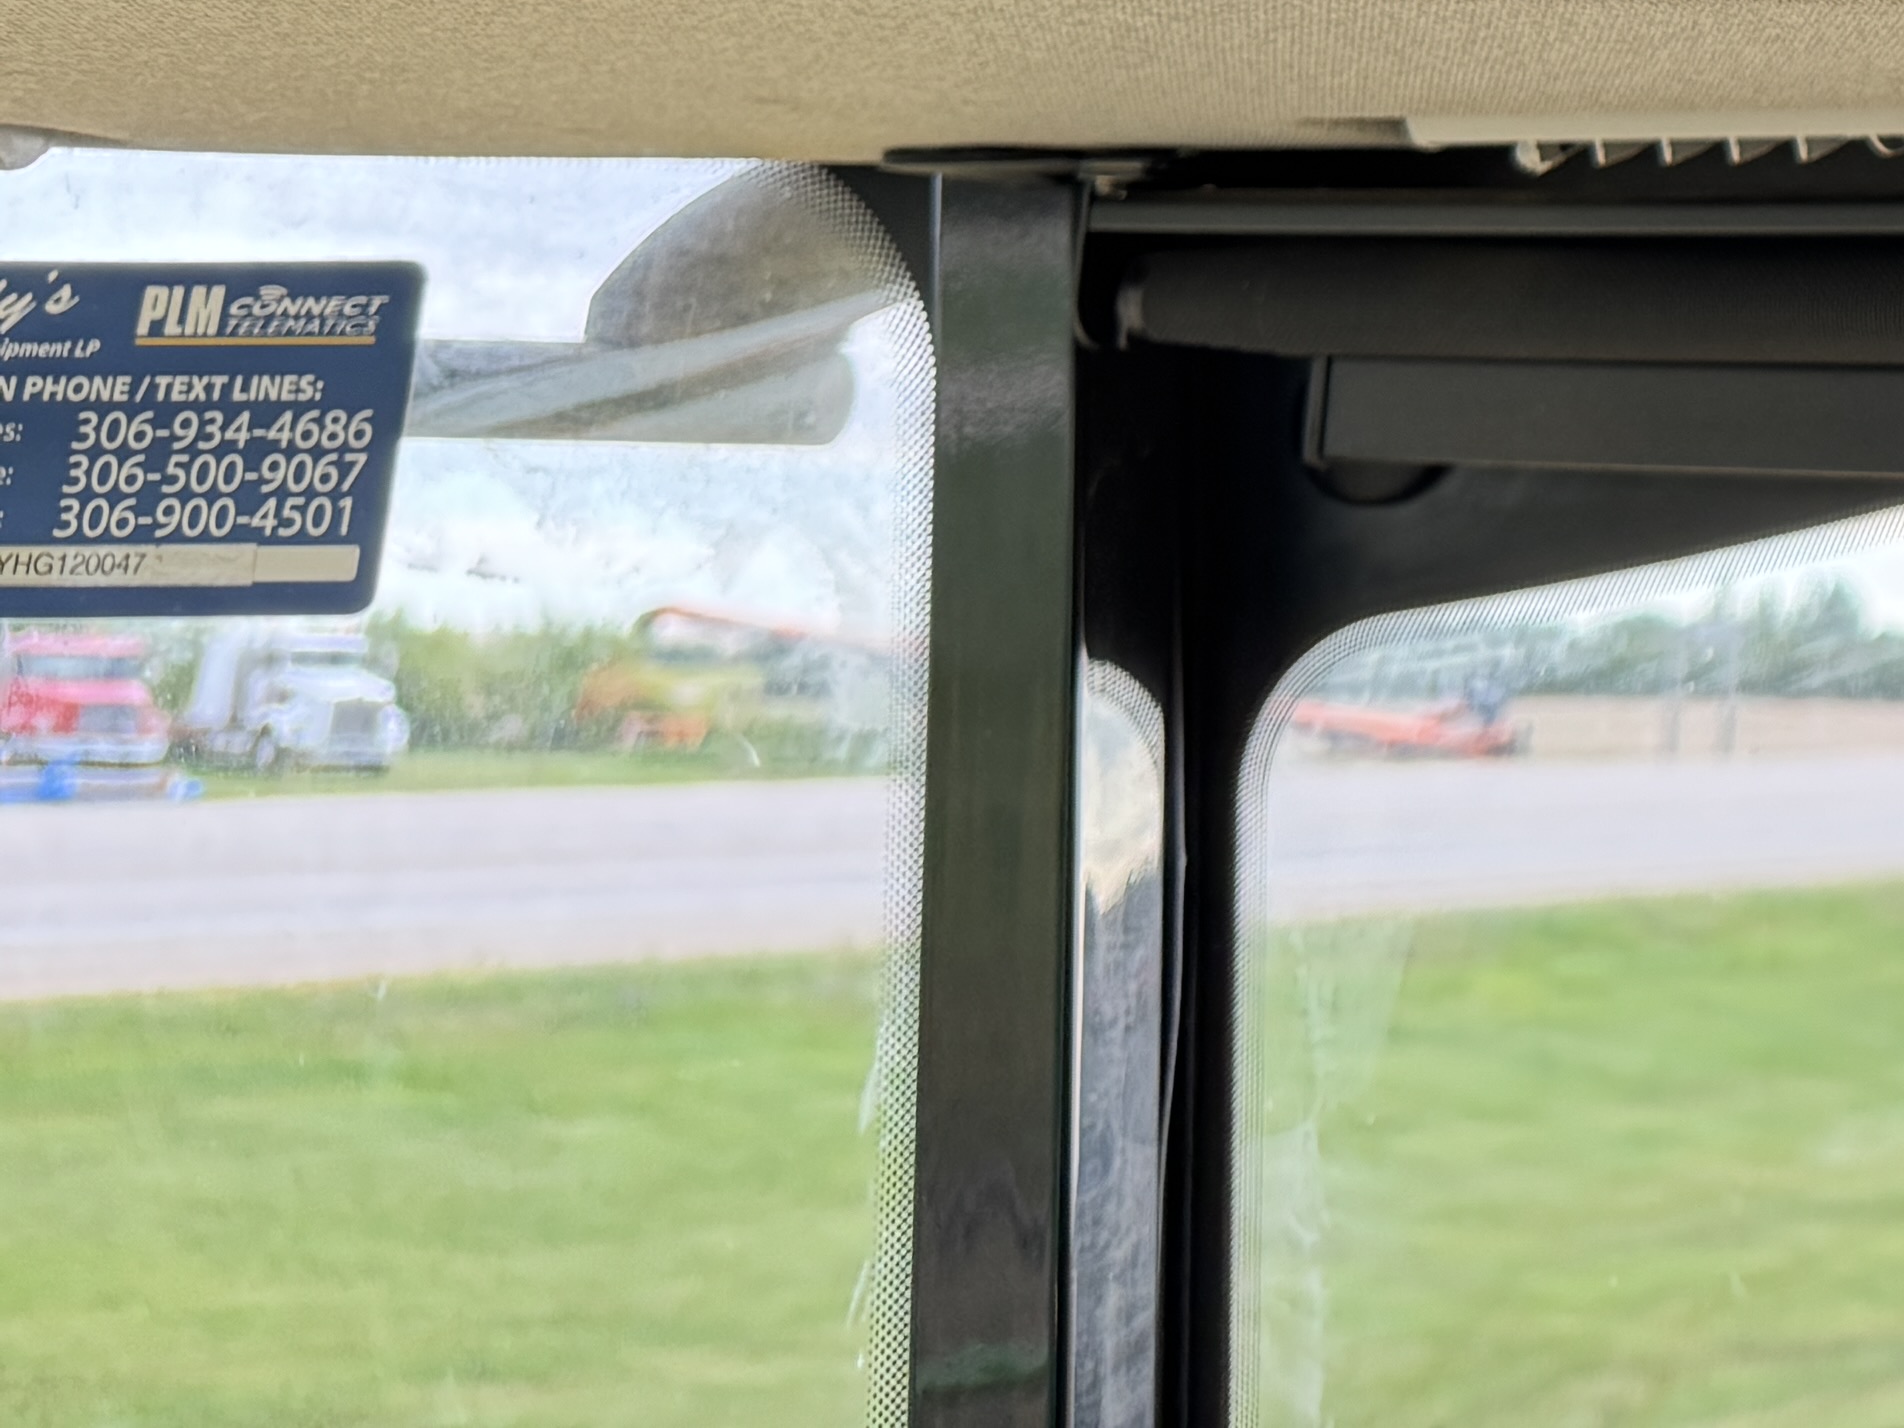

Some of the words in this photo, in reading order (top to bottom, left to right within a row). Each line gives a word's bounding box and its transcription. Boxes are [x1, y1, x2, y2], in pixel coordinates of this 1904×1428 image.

[0, 269, 80, 335] y's
[136, 285, 226, 336] PLM
[229, 285, 390, 318] CONNECT
[225, 317, 380, 336] TELEMATICS
[74, 338, 101, 358] LP
[22, 374, 132, 402] PHONE
[134, 374, 151, 403] /
[154, 374, 229, 402] TEXT
[232, 374, 325, 402] LINES:
[70, 409, 374, 451] 306-934-4686
[62, 453, 368, 494] 306-500-9067
[52, 496, 353, 539] 306-900-4501
